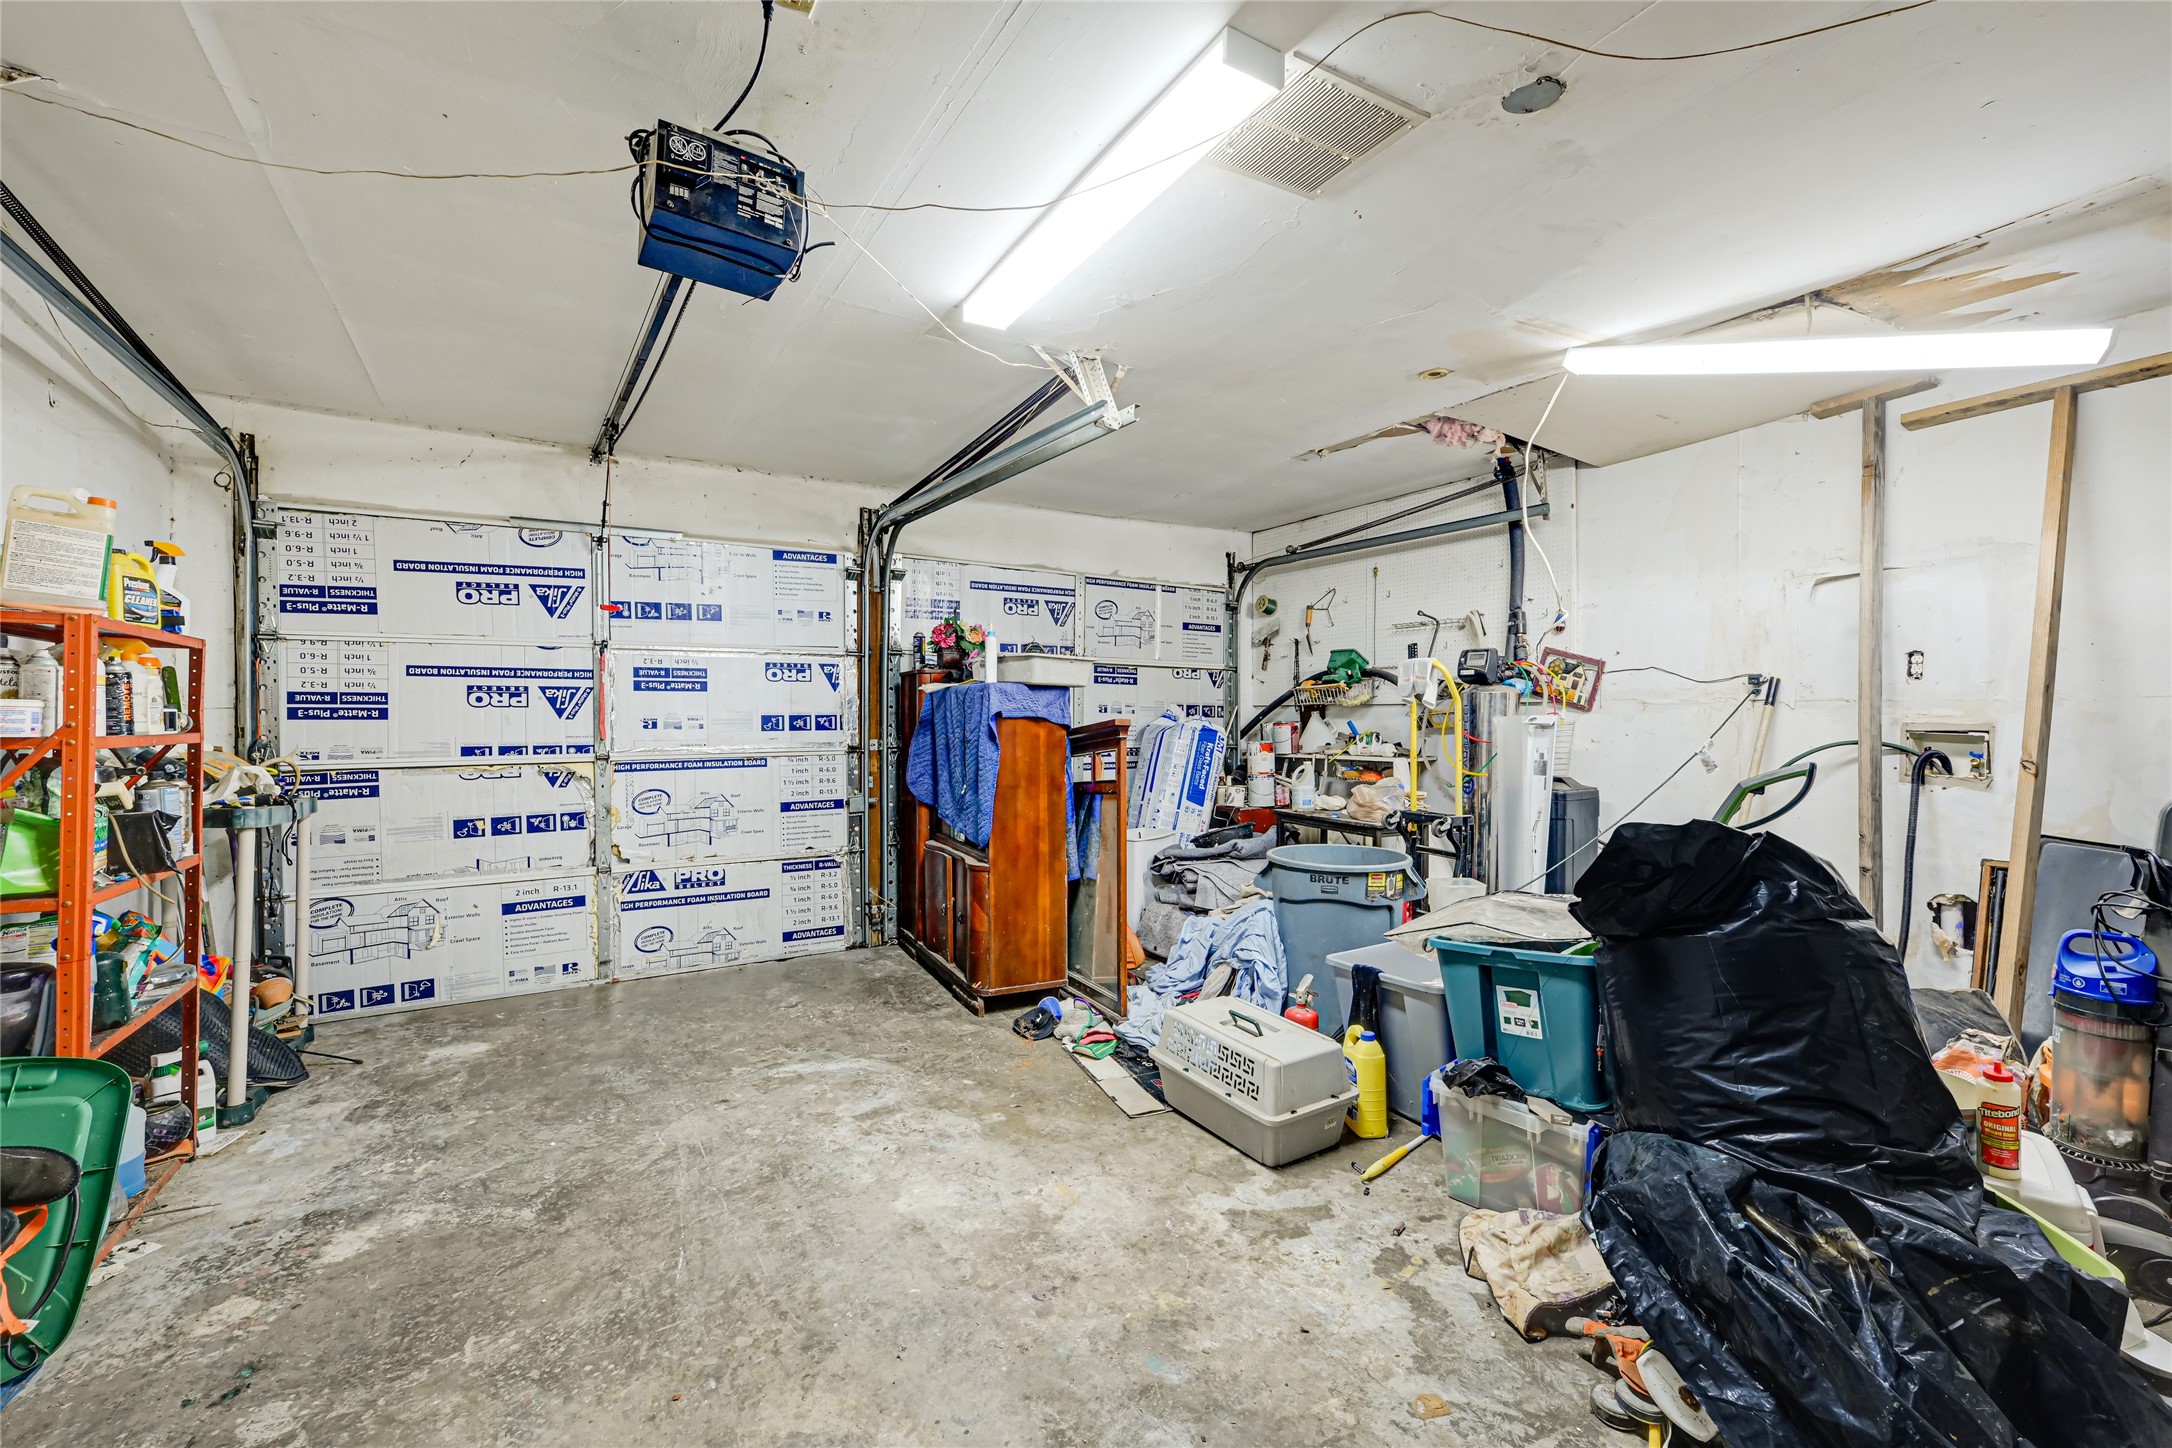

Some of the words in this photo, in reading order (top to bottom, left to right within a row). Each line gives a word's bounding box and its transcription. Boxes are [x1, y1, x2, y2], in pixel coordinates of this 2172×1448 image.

[281, 516, 312, 524] R-13.1
[329, 518, 349, 526] inch
[285, 530, 312, 538] R-9.6
[330, 533, 350, 541] inch
[286, 545, 314, 553] R-6.0
[330, 547, 350, 555] inch
[782, 553, 828, 562] ADVANTAGES
[286, 559, 314, 568] R-5.0
[330, 561, 352, 570] inch
[396, 562, 426, 570] BOARD
[428, 563, 478, 572] INSULATION
[480, 566, 504, 574] FOAM
[505, 567, 562, 576] PERFORMANCE
[288, 574, 315, 582] R-3.2
[332, 576, 352, 584] inch
[330, 589, 375, 597] THICKNESS
[457, 589, 518, 605] PRO
[536, 587, 567, 608] Sika
[286, 602, 319, 612] Plus-3
[1004, 603, 1039, 616] PRO
[300, 666, 328, 674] R-5.0
[408, 667, 438, 675] BOARD
[440, 668, 490, 676] INSULATION
[516, 670, 572, 678] PERFORMANCE
[765, 668, 811, 682] PRO
[468, 692, 528, 708] PRO
[545, 688, 576, 709] Sika
[298, 709, 330, 718] Plus-3
[614, 763, 631, 772] HIGH
[632, 762, 682, 770] PERFORMANCE
[1199, 742, 1214, 790] Kraft-Faced
[790, 801, 835, 810] ADVANTAGES
[676, 869, 726, 883] PRO
[1310, 874, 1350, 884] BRUTE
[631, 871, 660, 891] Sika
[679, 881, 721, 889] SELECT
[522, 888, 540, 896] inch
[554, 884, 578, 892] R-13.1
[515, 898, 574, 912] ADVANTAGES
[635, 898, 686, 908] PERFORMANCE
[686, 896, 706, 904] FOAM
[706, 893, 746, 902] INSULATION
[310, 903, 343, 914] COMPLETE
[792, 928, 837, 940] ADVANTAGES
[310, 960, 340, 968] Basement
[1978, 1106, 2020, 1118] Titebond
[1984, 1120, 2016, 1132] ORIGINAL
